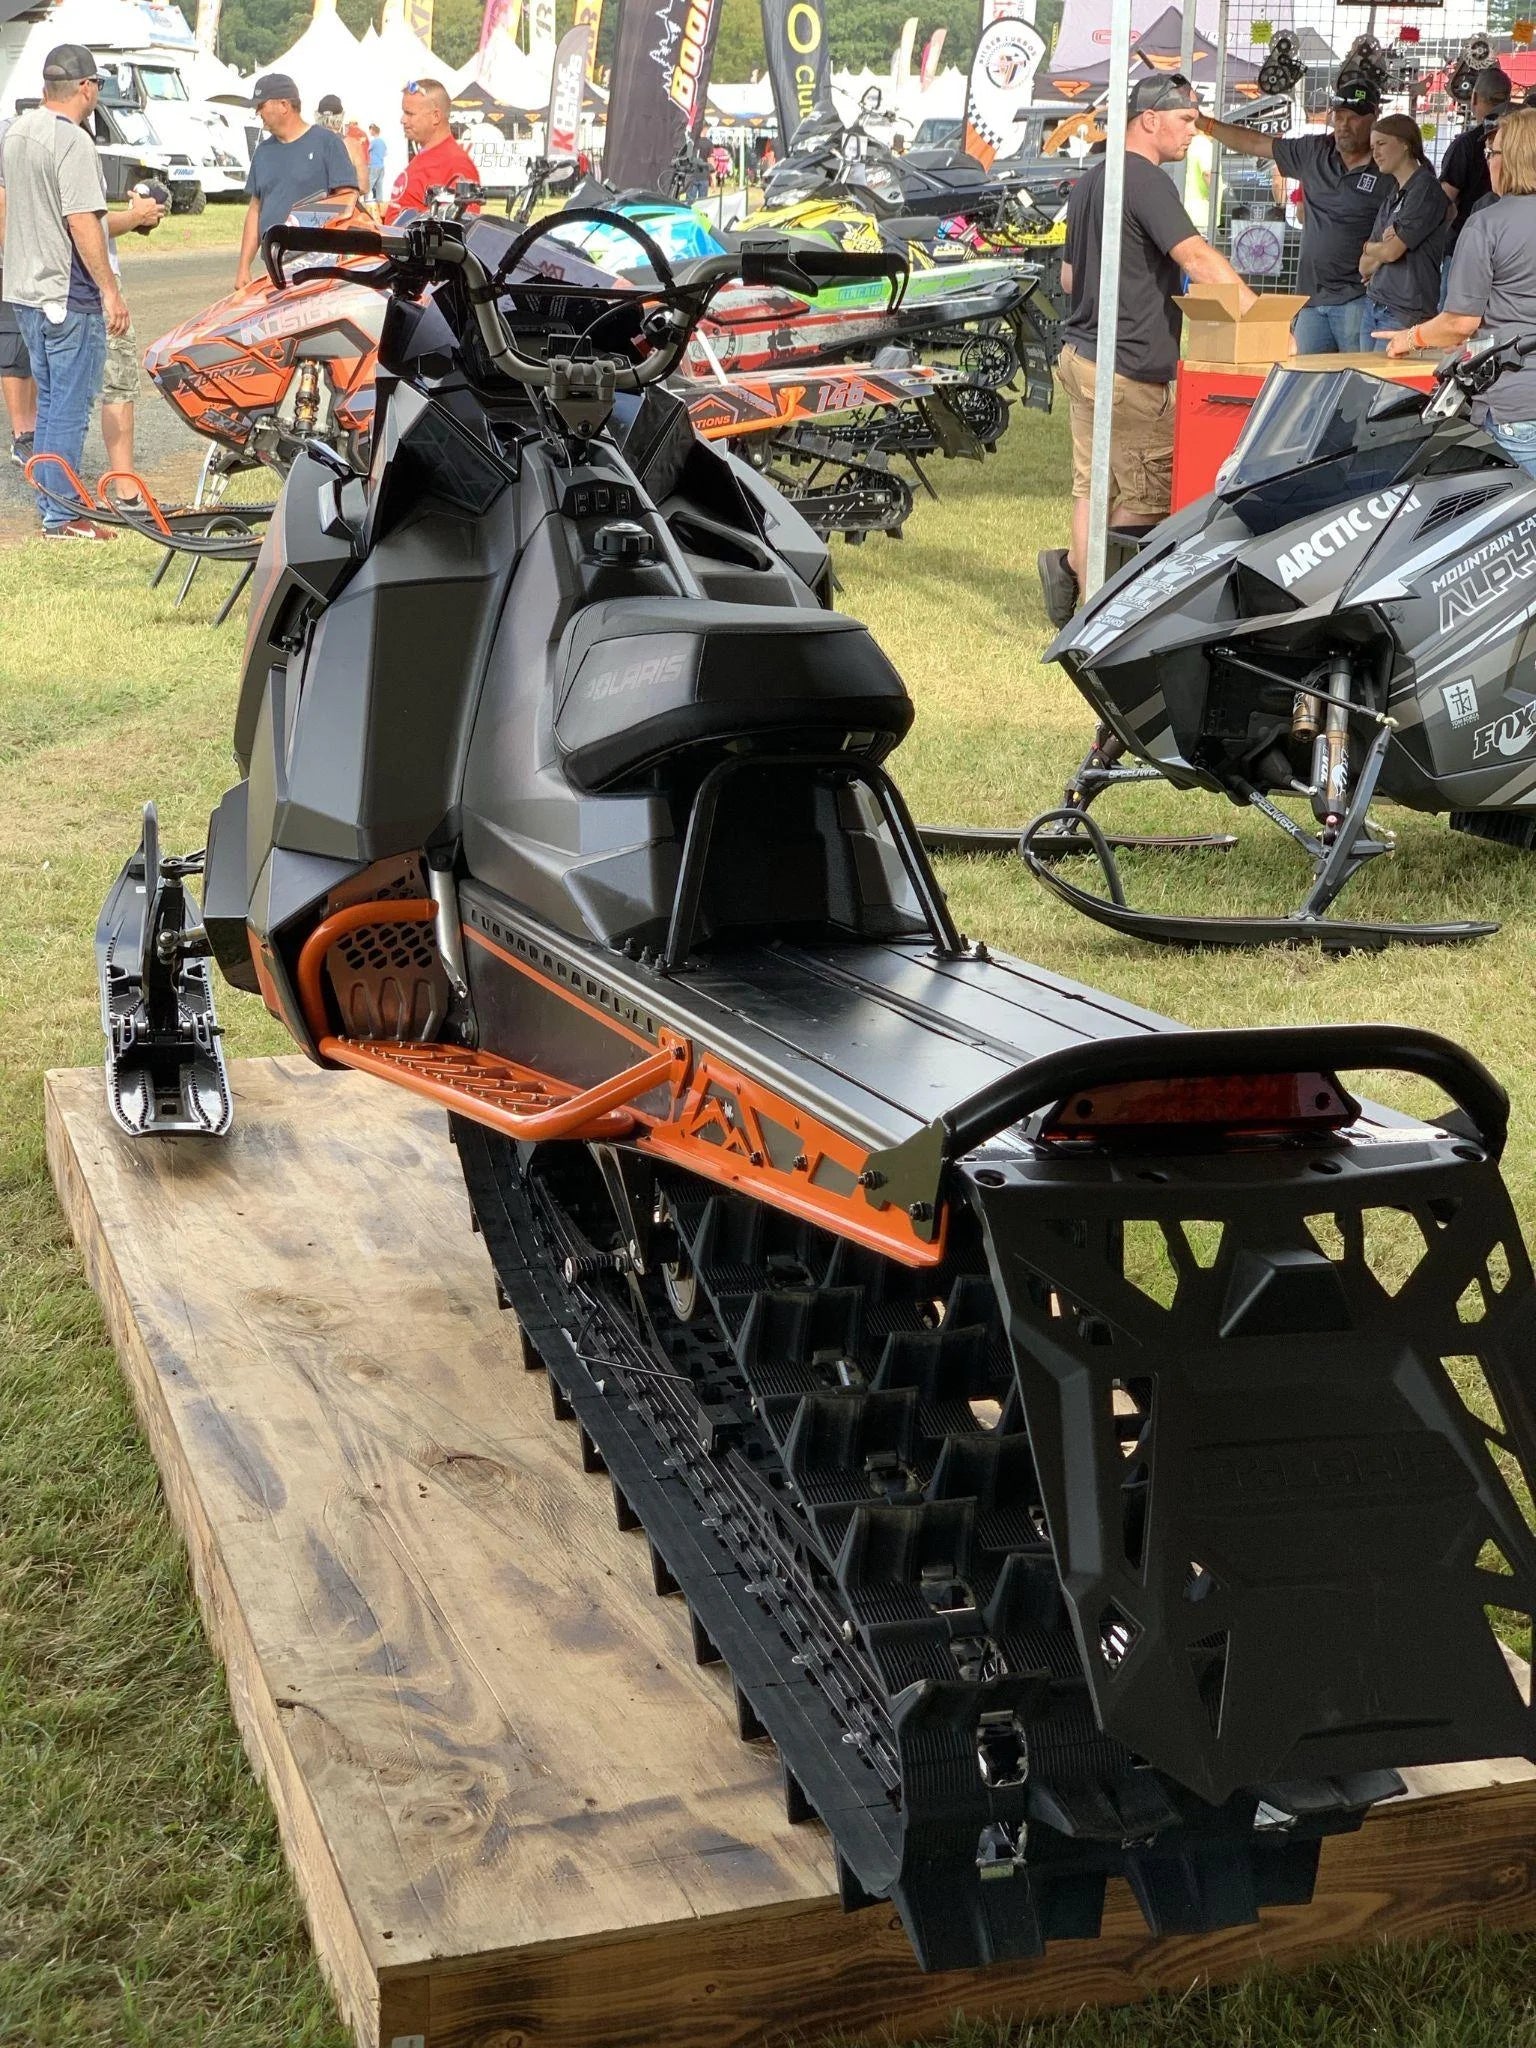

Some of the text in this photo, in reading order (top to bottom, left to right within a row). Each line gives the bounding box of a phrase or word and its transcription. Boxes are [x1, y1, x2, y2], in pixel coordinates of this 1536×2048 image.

[670, 0, 713, 114] BOO
[816, 381, 867, 414] 146
[1276, 484, 1422, 588] ARCTIC CAT
[1431, 530, 1515, 594] MOUNTAIN
[583, 654, 688, 701] POLARIS
[1472, 700, 1536, 760] FOX
[1248, 791, 1302, 837] SPEEDWERX
